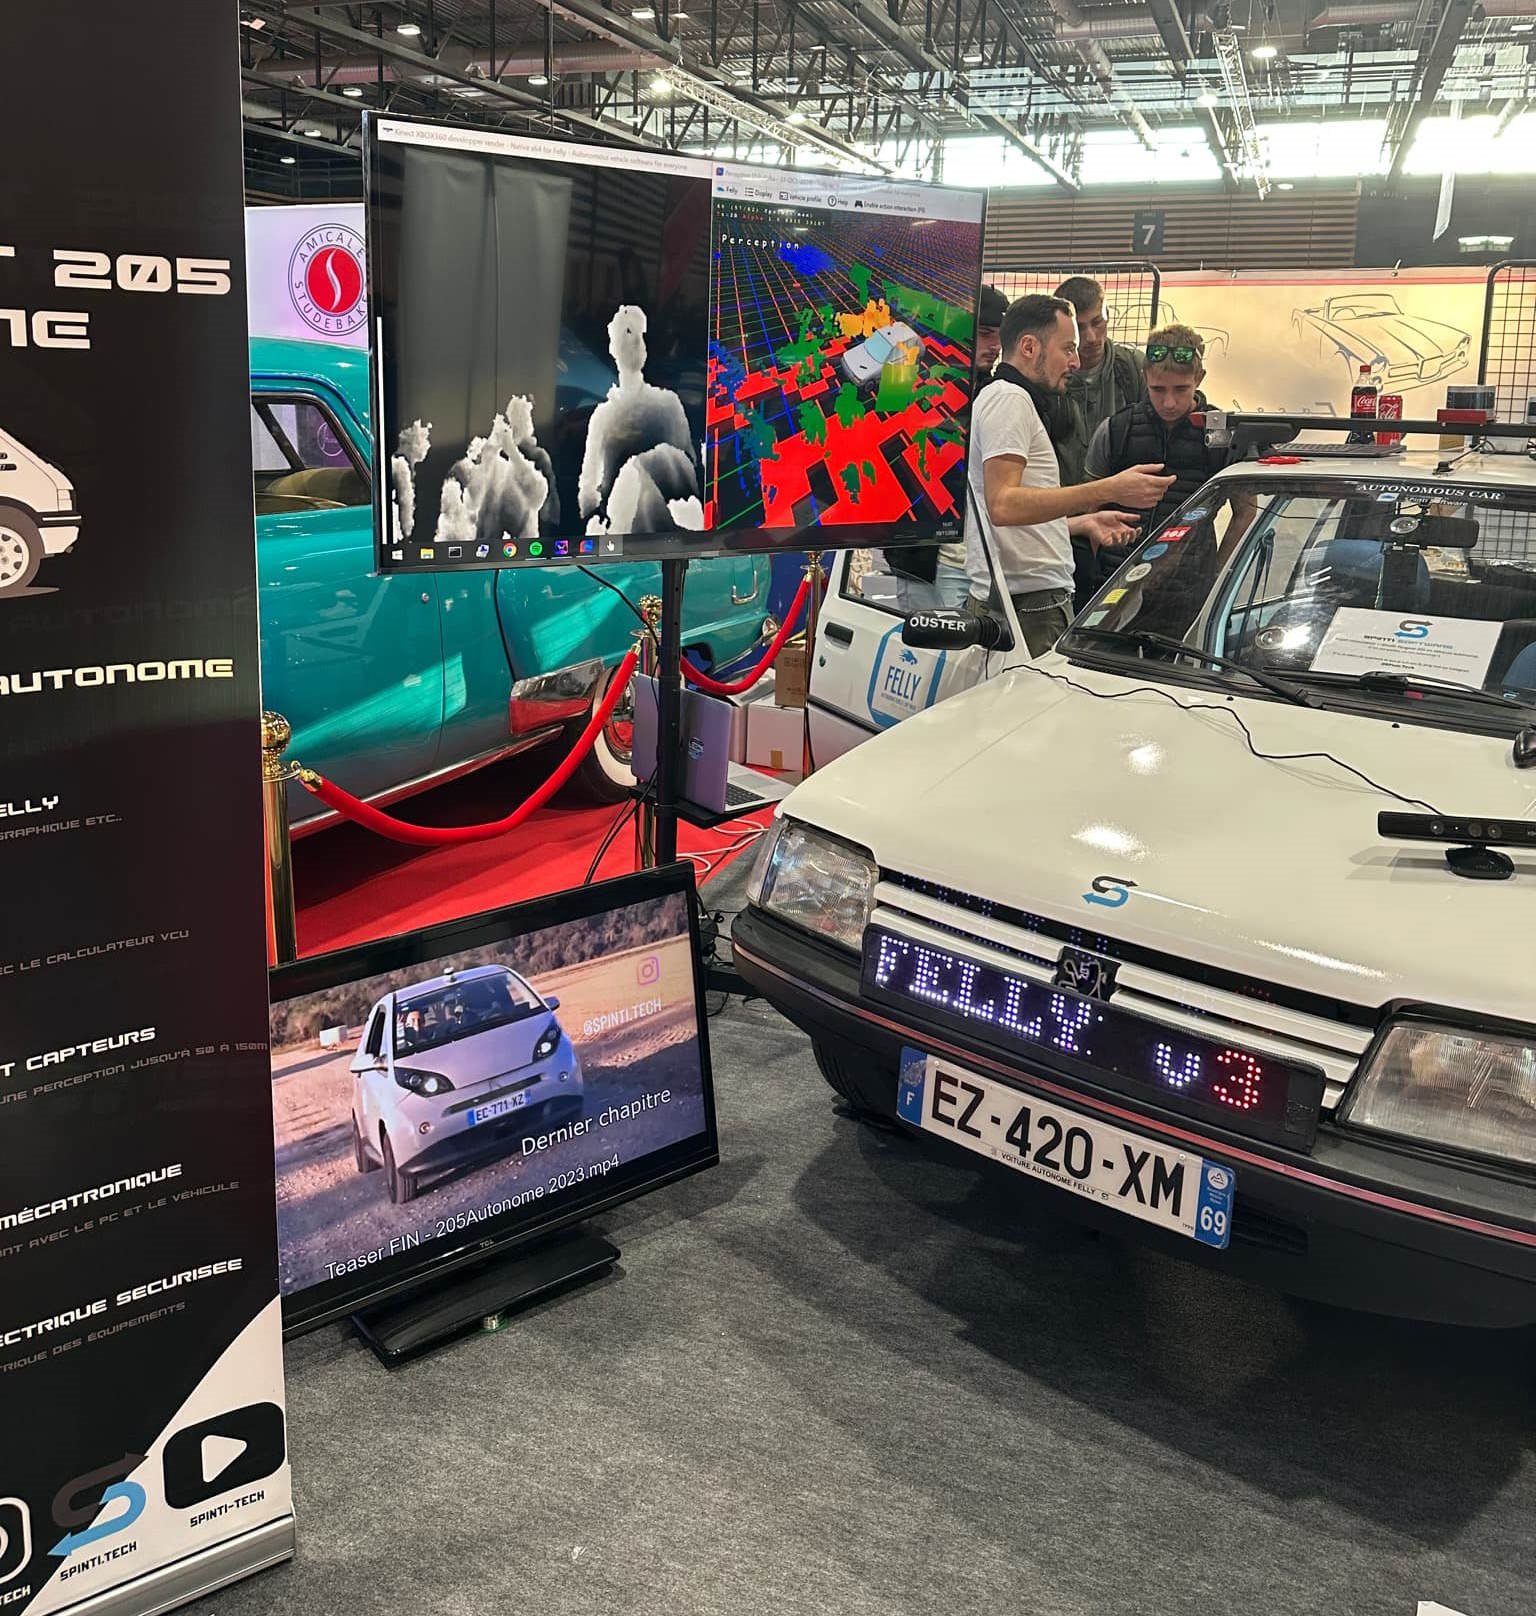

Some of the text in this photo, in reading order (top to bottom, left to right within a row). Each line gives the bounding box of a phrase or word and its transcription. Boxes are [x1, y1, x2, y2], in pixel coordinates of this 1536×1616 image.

[299, 231, 365, 263] AMICALE
[722, 233, 799, 250] Perception
[1142, 225, 1156, 245] 7
[53, 249, 231, 295] 205
[1357, 484, 1502, 500] AUTONOMOUS CAR
[909, 615, 967, 633] OUSTER
[884, 665, 922, 701] FELLY
[20, 958, 41, 971] LE
[46, 935, 155, 965] CALCULATEUR
[160, 929, 190, 942] VCU
[874, 935, 1093, 1054] FELLY
[26, 1027, 156, 1071] CAPTEURS
[33, 1064, 126, 1097] PERCEPTION
[906, 1091, 915, 1106] F
[521, 1088, 672, 1157] Dernier chapitre
[931, 1072, 1186, 1219] EZ-420-XM
[1001, 1152, 1097, 1195] VOITURE AUTONOME FELLY
[0, 1163, 183, 1231] MÉCATRONIQUE
[325, 1243, 385, 1281] Teaser
[389, 1229, 420, 1257] FIN
[436, 1184, 545, 1243] 205Autonome
[548, 1152, 620, 1195] 2023.mp4
[29, 1229, 69, 1249] AVEC
[74, 1220, 95, 1233] LE
[99, 1212, 119, 1225] PC
[123, 1205, 143, 1217] ET
[148, 1198, 168, 1209] LE
[1200, 1206, 1226, 1236] 69
[0, 1258, 243, 1348] CTRIQUE SECURISEE
[53, 1338, 82, 1356] DES
[190, 1490, 266, 1528] SPINTI-TECH
[60, 1541, 138, 1582] SPINTI.TECH
